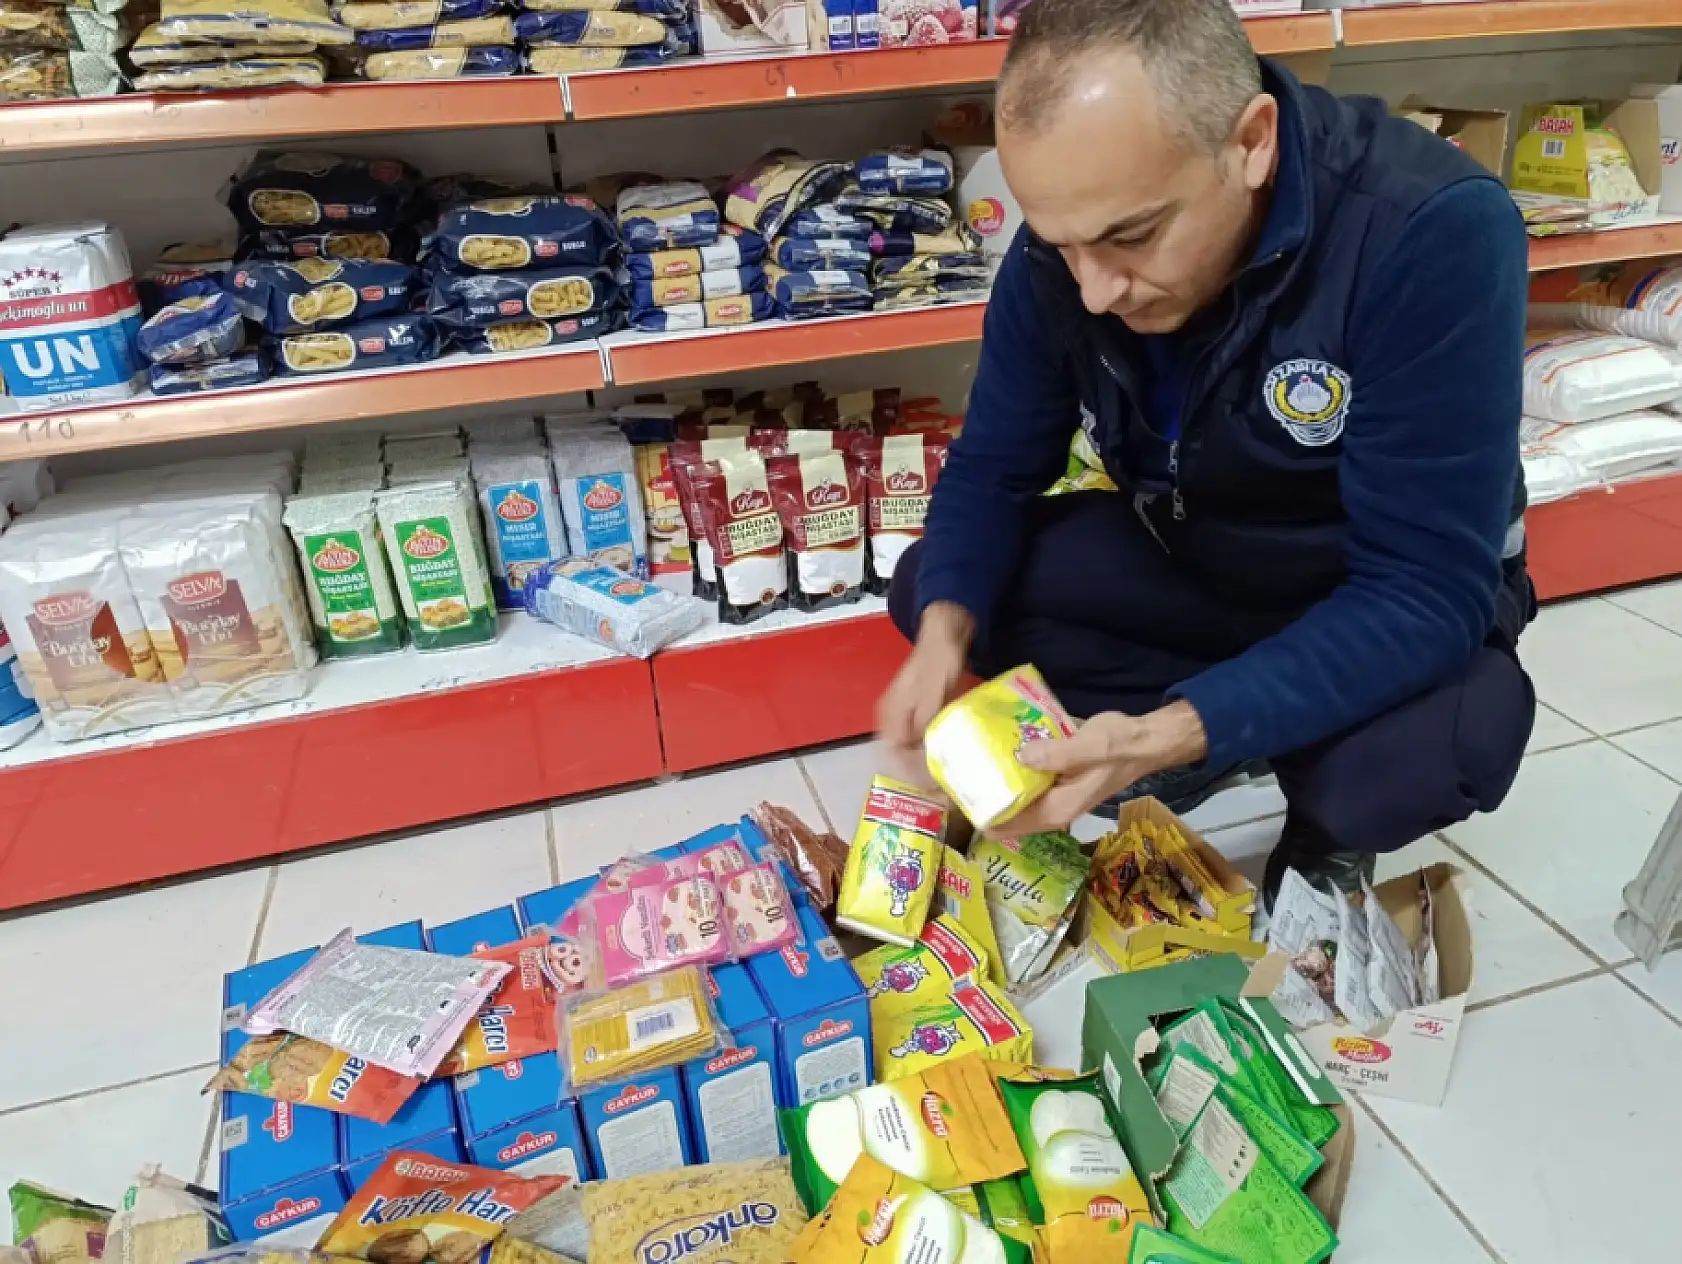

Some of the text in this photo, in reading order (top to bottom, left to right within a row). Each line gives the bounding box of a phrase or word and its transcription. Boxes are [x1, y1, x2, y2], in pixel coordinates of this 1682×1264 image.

[10, 335, 101, 378] UN
[170, 576, 224, 600] SELVA
[987, 854, 1047, 904] Yayla
[640, 1201, 779, 1264] ankara
